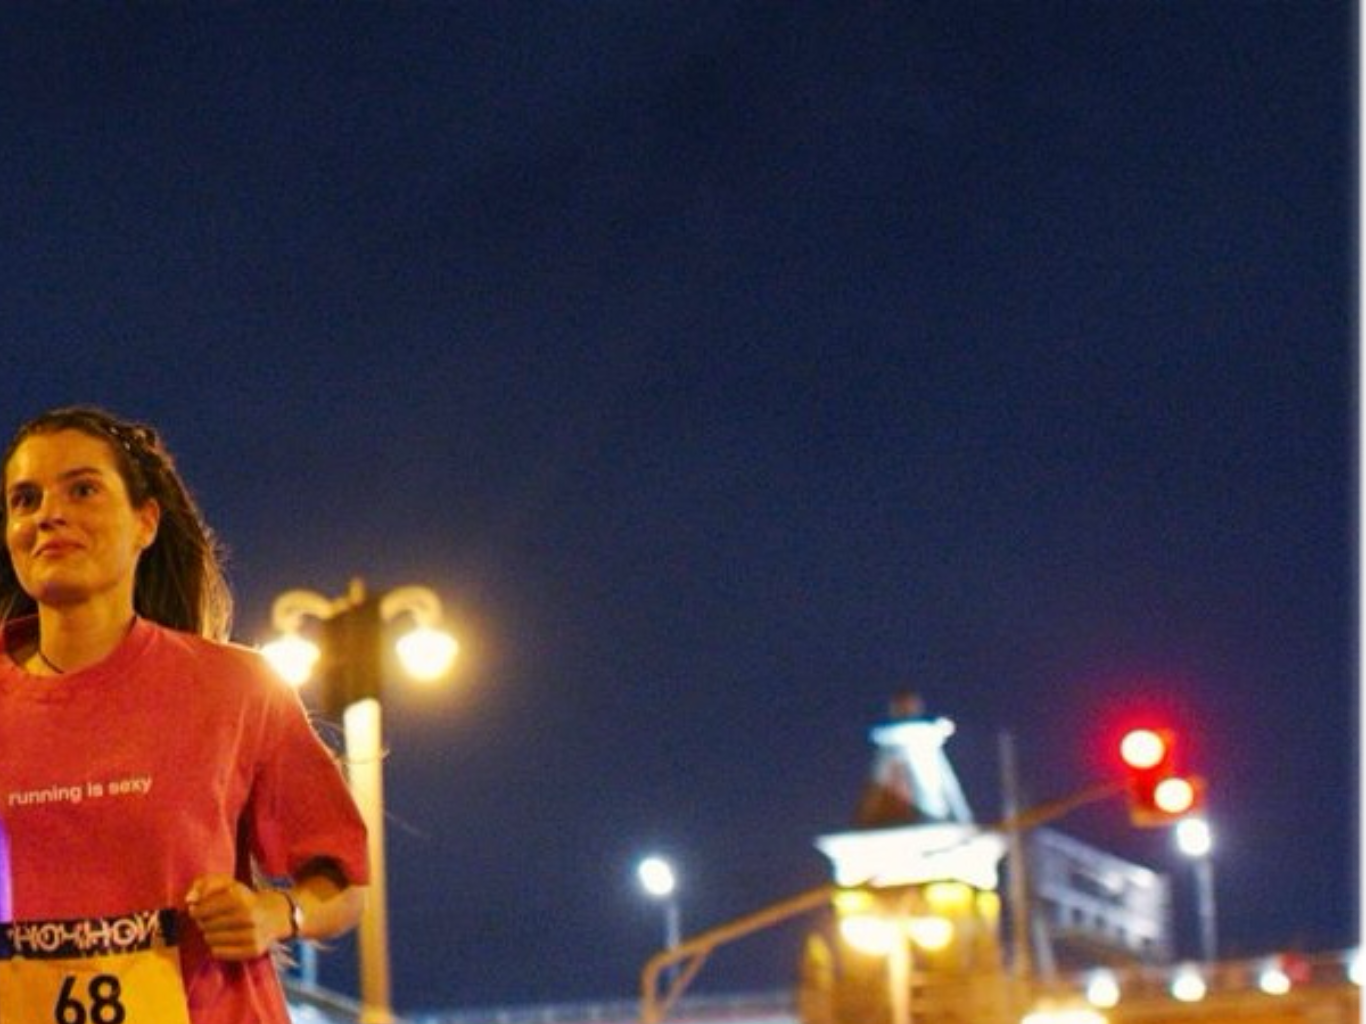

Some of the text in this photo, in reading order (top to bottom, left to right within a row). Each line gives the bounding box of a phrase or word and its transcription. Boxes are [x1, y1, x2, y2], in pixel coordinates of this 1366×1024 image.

[8, 775, 153, 807] running is sexy
